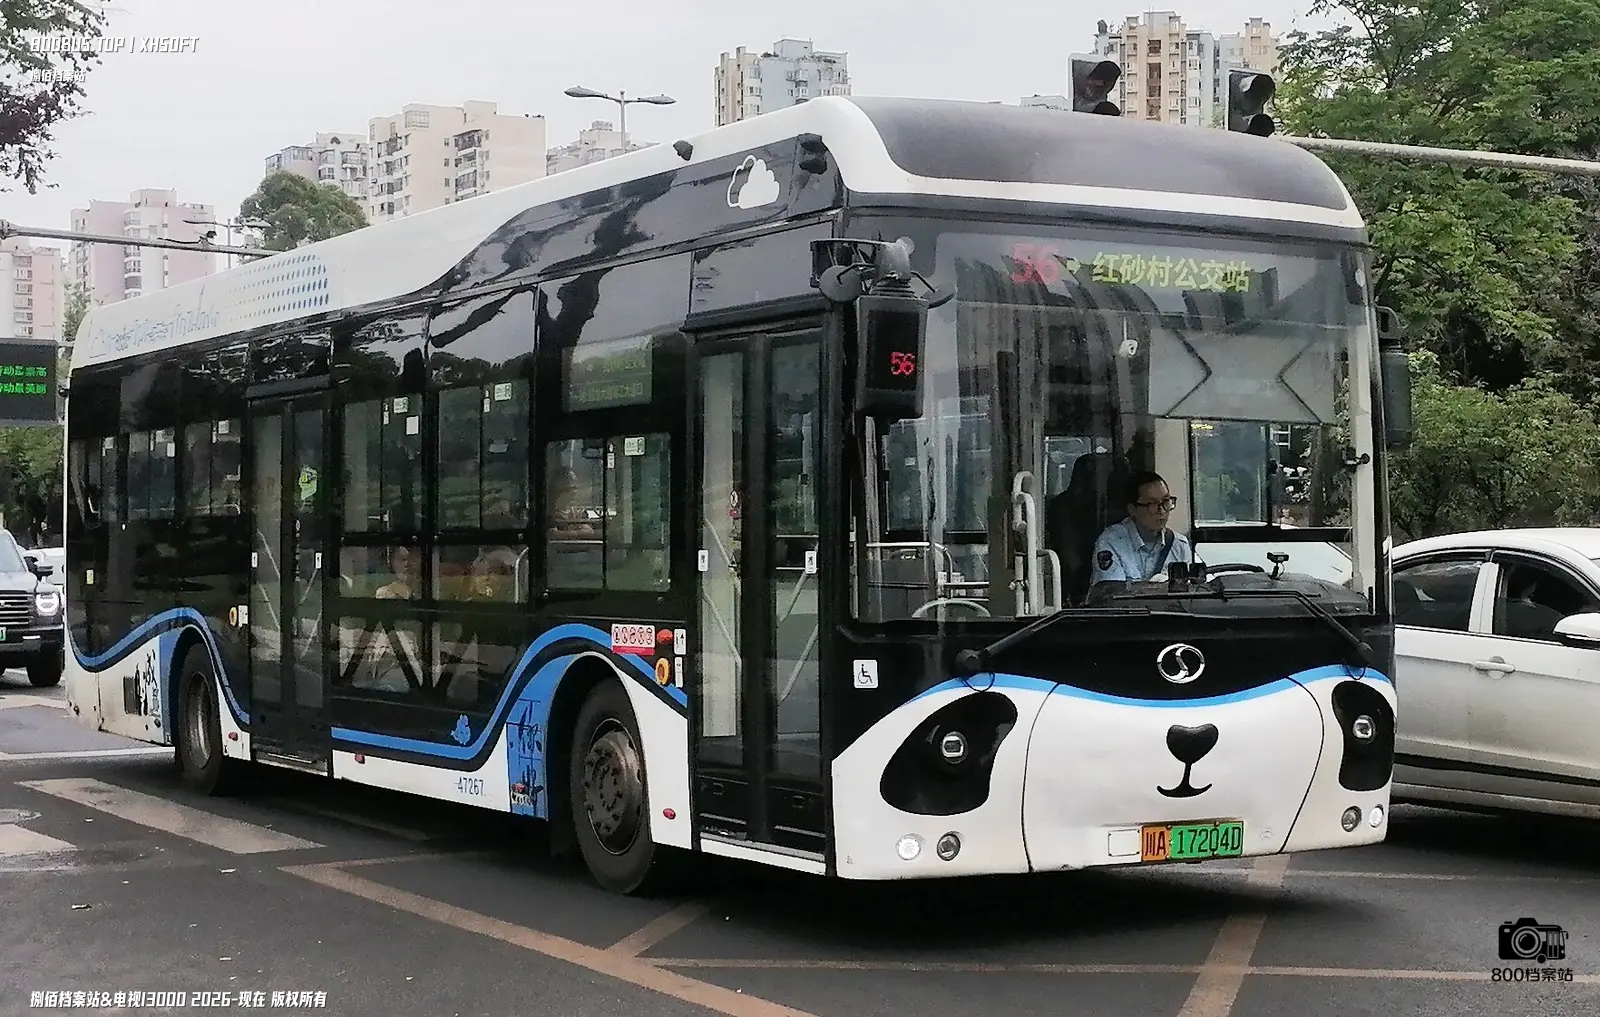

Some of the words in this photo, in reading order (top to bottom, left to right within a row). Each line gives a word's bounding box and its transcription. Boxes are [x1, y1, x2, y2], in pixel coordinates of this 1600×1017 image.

[1010, 242, 1060, 282] 56
[1091, 251, 1251, 293] 红砂村公交站
[891, 351, 915, 376] 56
[457, 776, 484, 797] 47267
